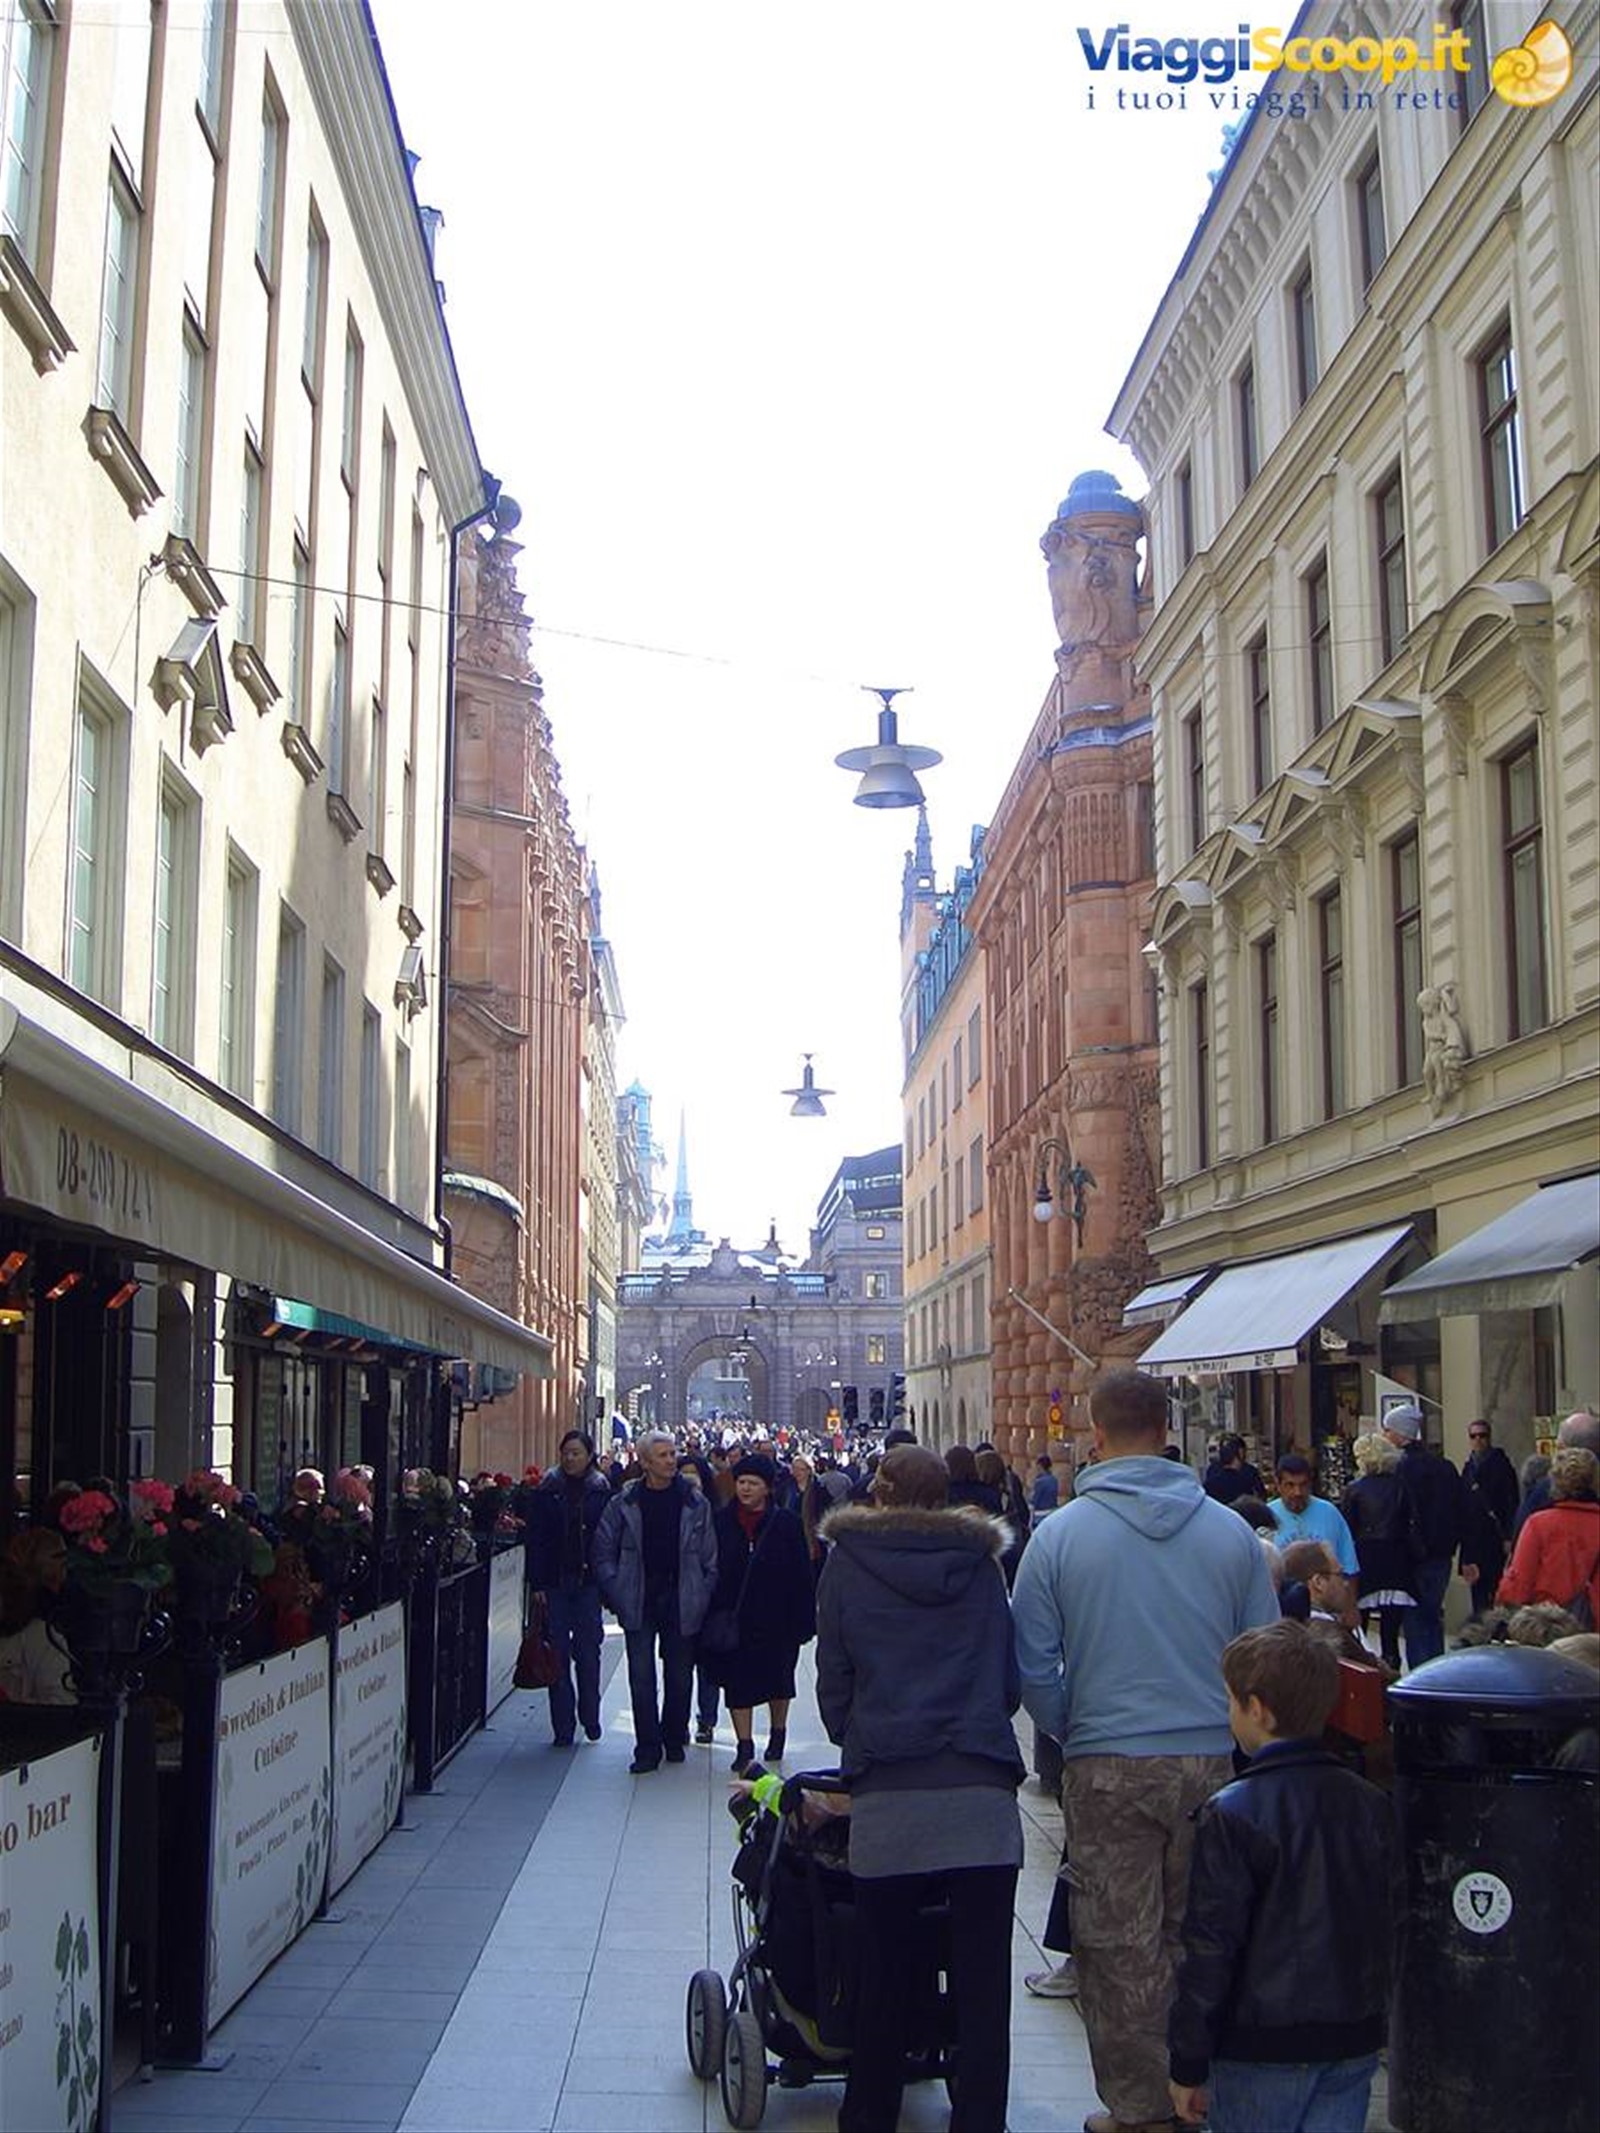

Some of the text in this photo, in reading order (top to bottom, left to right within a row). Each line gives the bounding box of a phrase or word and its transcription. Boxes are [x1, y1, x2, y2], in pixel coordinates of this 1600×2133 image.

[276, 1686, 286, 1712] &
[254, 1730, 298, 1773] Cuisine
[27, 1792, 71, 1841] bar
